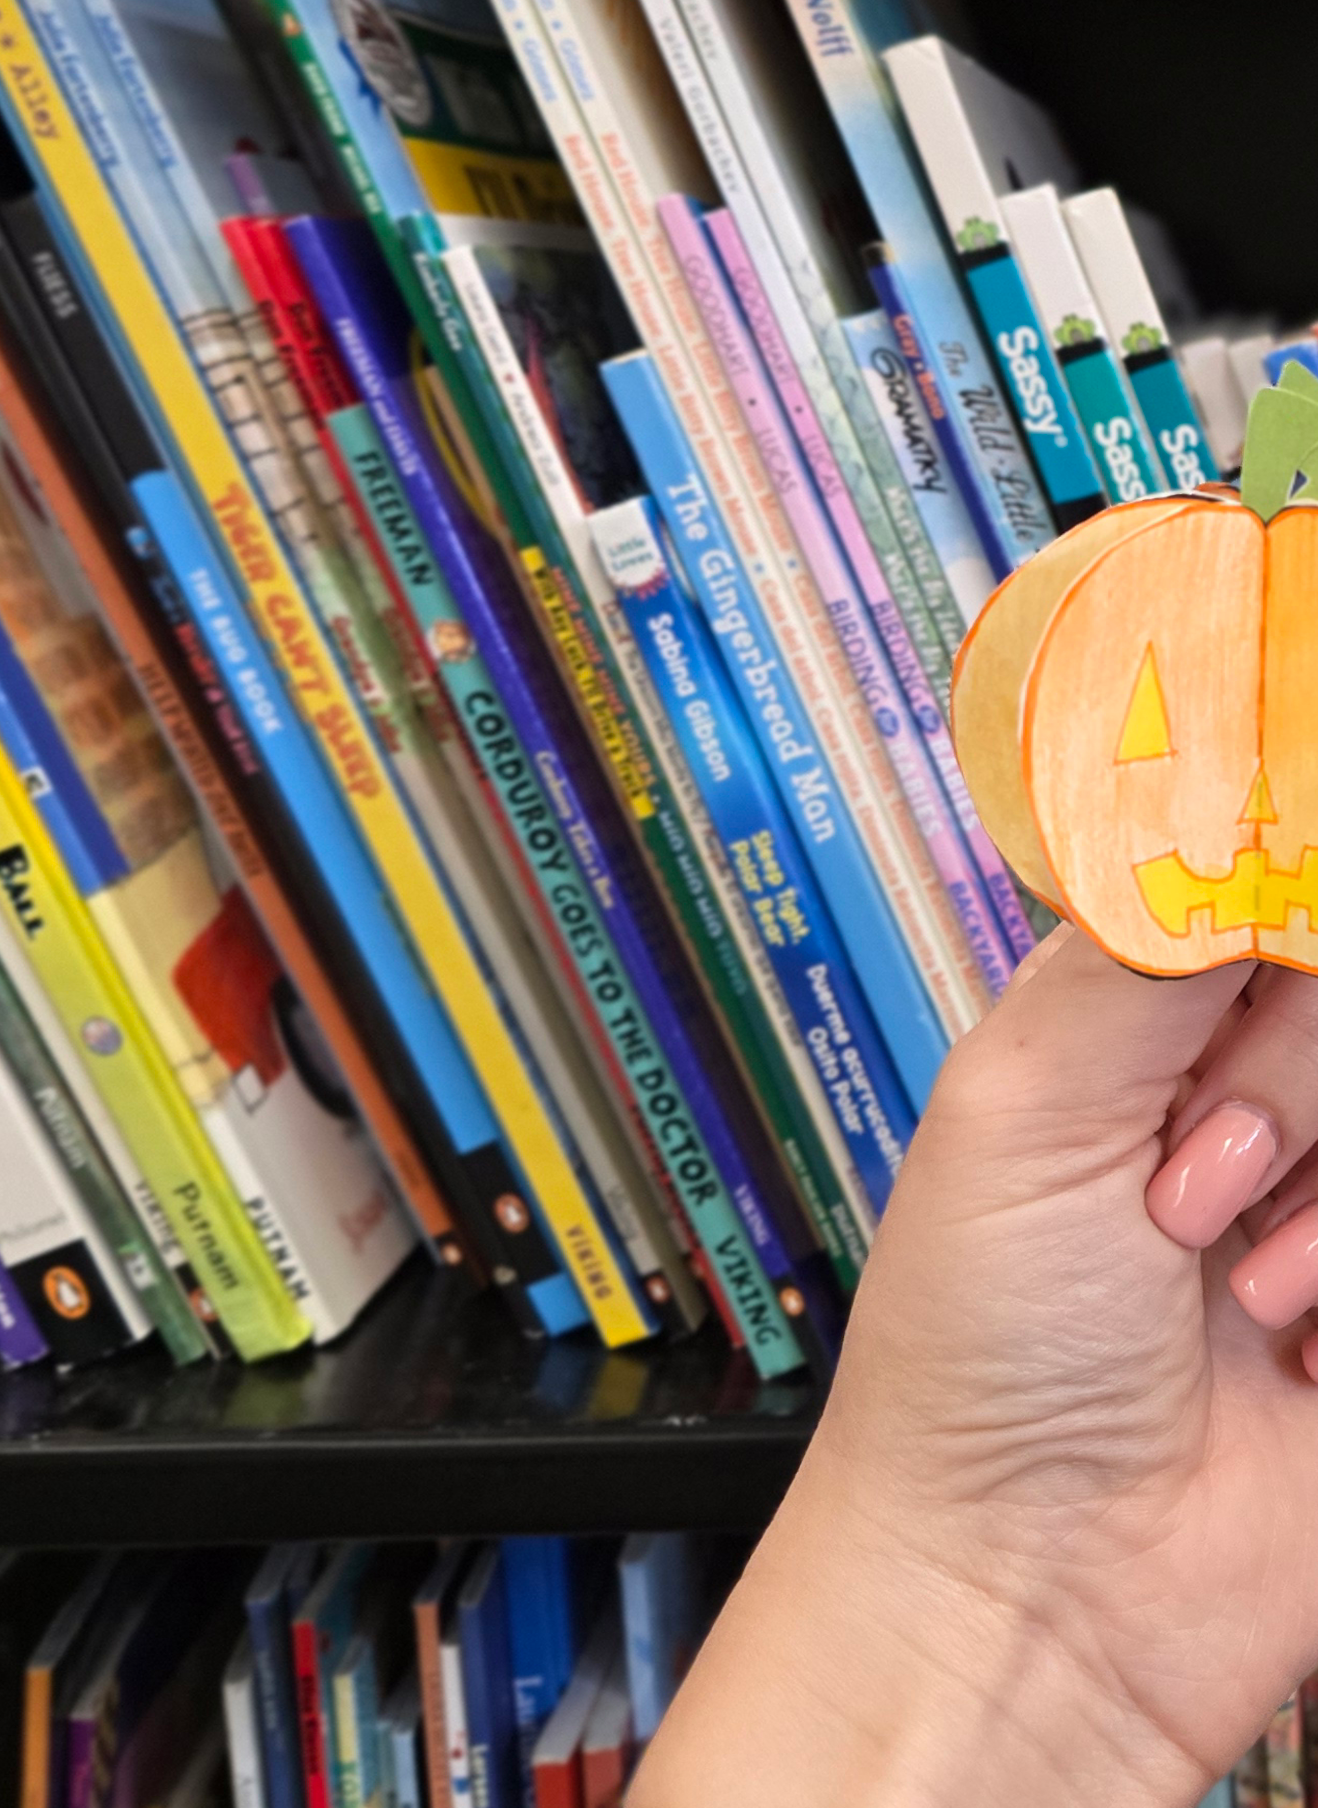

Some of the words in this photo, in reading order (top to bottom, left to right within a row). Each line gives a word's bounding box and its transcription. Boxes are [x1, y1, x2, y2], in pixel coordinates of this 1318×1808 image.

[4, 54, 65, 145] Alley
[682, 251, 751, 379] GOODHART
[752, 425, 799, 496] LUCAS
[864, 341, 950, 502] GRAMATKY
[888, 311, 922, 360] Gray
[914, 368, 946, 421] Bono
[992, 322, 1070, 443] Sassy
[798, 432, 840, 500] LUCAS
[937, 335, 973, 381] The
[957, 380, 1015, 462] Wild
[988, 457, 1050, 545] Little
[1094, 416, 1147, 499] Sass
[663, 471, 722, 545] The
[187, 566, 222, 611] THE
[211, 612, 248, 664] BUG
[237, 665, 284, 737] BOOK
[205, 477, 285, 589] TIGER
[257, 586, 336, 704] CAN'T
[310, 700, 386, 808] SLEEP
[643, 609, 705, 699] Sabina
[679, 695, 739, 783] Gibson
[682, 542, 820, 769] Gingerbread
[786, 762, 849, 845] Man
[869, 594, 939, 705] BIRDING
[925, 736, 986, 832] BABIES
[981, 870, 1038, 962] BACKYA
[350, 446, 440, 591] FREEMAN
[458, 683, 575, 880] CORDUROY
[545, 875, 607, 960] GOES
[582, 957, 627, 1008] TO
[606, 1006, 655, 1066] THE
[632, 1063, 724, 1209] DOCTOR
[709, 1232, 783, 1349] VIKING
[725, 837, 768, 896] Polar
[749, 895, 791, 951] Bear
[743, 827, 790, 889] Sleep
[803, 1024, 844, 1082] Osito
[825, 1078, 870, 1139] Polar
[169, 1178, 244, 1295] Putnam
[241, 1194, 310, 1305] PUTNAM
